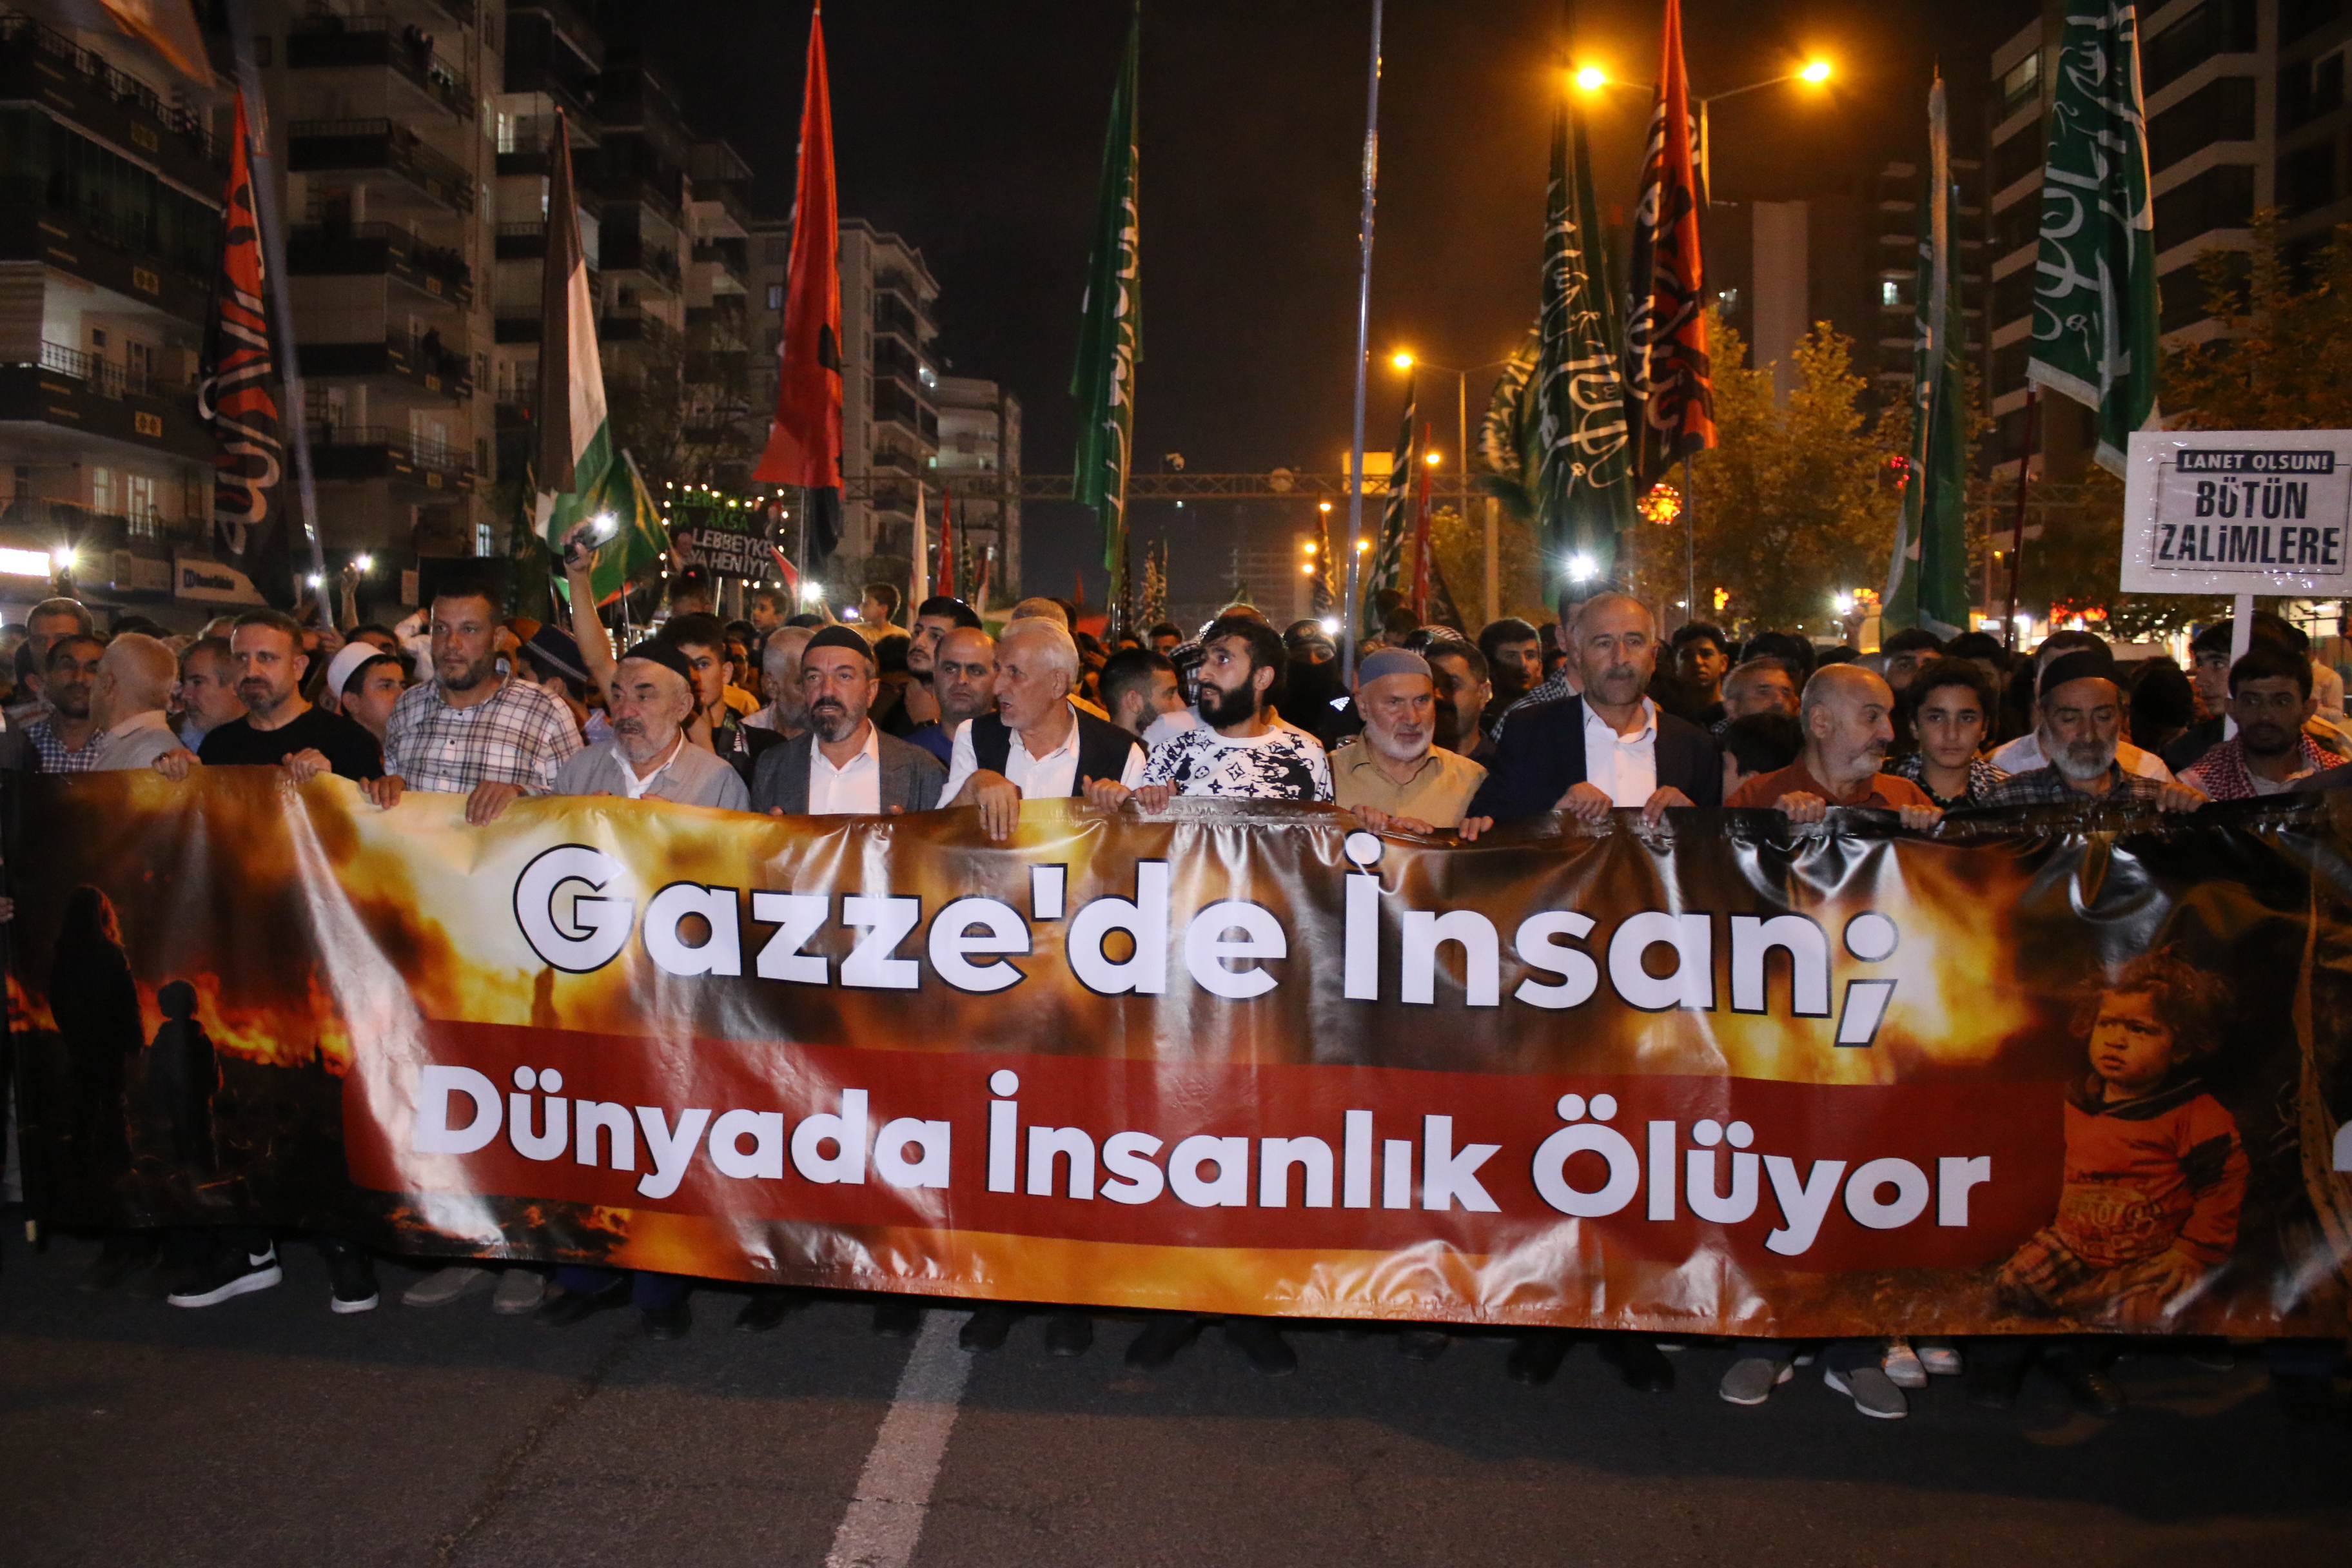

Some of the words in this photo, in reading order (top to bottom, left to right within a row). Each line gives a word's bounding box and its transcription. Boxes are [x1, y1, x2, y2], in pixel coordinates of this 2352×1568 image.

[2183, 454, 2245, 469] LANET
[2252, 454, 2328, 471] OLSUN!
[2195, 477, 2309, 520] BÜTÜN
[704, 510, 750, 532] AKSA
[691, 548, 708, 566] YA
[692, 527, 774, 559] LEBBEYKE
[2159, 524, 2340, 565] ZALİMLERE
[513, 843, 1288, 1000] Gazze'de
[1342, 828, 1899, 1048] İnsan;
[413, 1064, 952, 1199] Dünyada
[985, 1068, 1502, 1213] İnsanlık
[1532, 1093, 1992, 1257] Ölüyor
